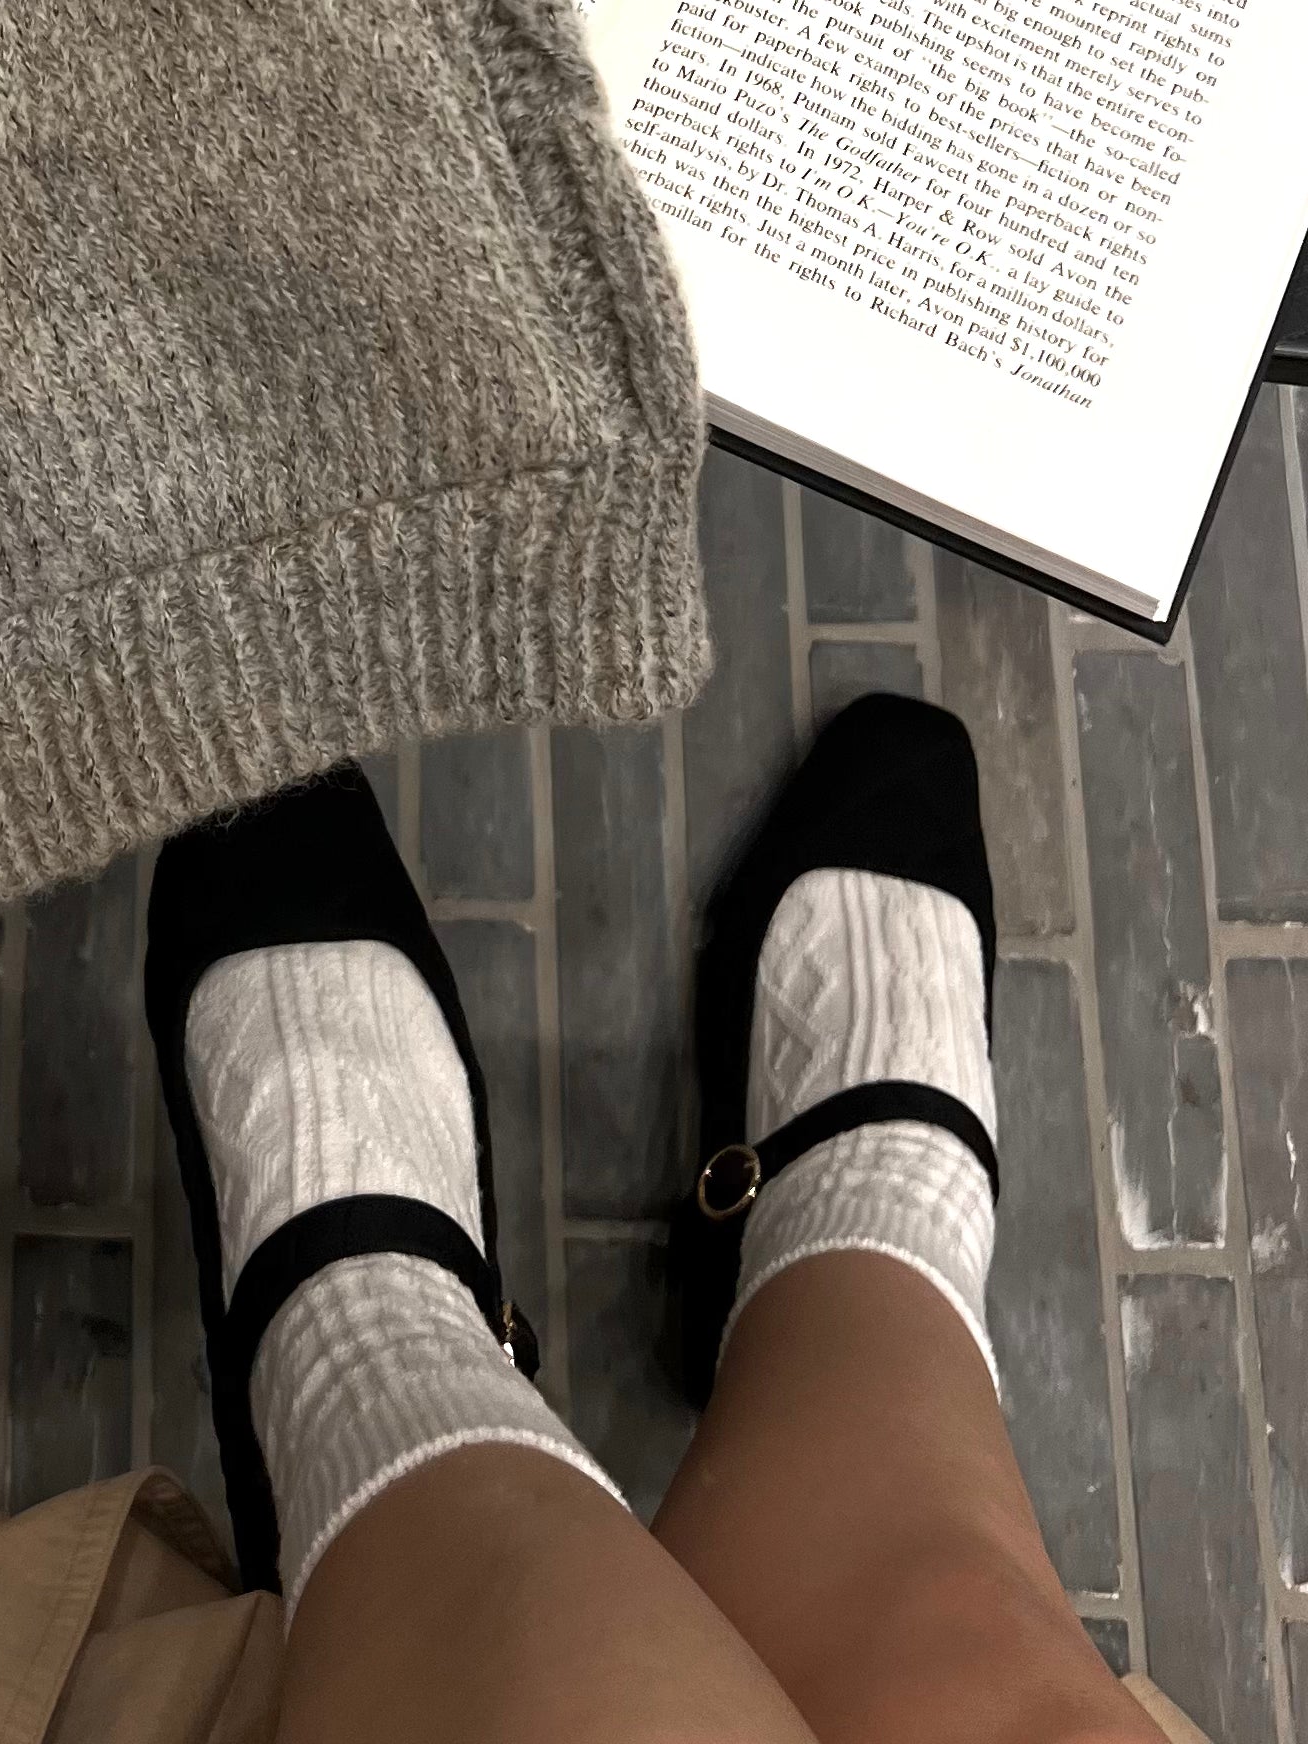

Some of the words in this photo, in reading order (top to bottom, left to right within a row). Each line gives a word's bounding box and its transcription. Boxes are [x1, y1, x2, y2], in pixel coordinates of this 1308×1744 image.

[796, 25, 811, 41] A
[817, 32, 850, 55] few
[854, 52, 930, 95] examples
[936, 91, 958, 106] of
[959, 100, 986, 121] the
[988, 117, 1039, 147] prices
[1046, 141, 1079, 165] that
[1084, 156, 1125, 185] have
[1130, 176, 1171, 206] been
[971, 14, 1061, 63] excitement
[1064, 58, 1122, 92] merely
[1128, 86, 1179, 116] serves
[1184, 110, 1202, 126] to
[1190, 23, 1231, 48] sums
[643, 76, 723, 116] thousand
[796, 140, 815, 160] In
[872, 176, 934, 214] Harper
[938, 209, 955, 226] &
[961, 218, 1002, 246] Row
[1008, 243, 1045, 267] sold
[1049, 261, 1097, 291] Avon
[1104, 285, 1133, 306] the
[718, 58, 737, 77] In
[792, 91, 856, 132] Putnam
[862, 127, 899, 150] sold
[901, 142, 969, 185] Fawcett
[974, 178, 1001, 199] the
[1004, 195, 1093, 242] paperback
[1099, 237, 1147, 265] rights
[719, 225, 747, 247] for
[754, 242, 781, 264] the
[788, 260, 836, 291] rights
[844, 285, 862, 302] to
[869, 295, 938, 338] Richard
[1009, 363, 1093, 409] Jonathan
